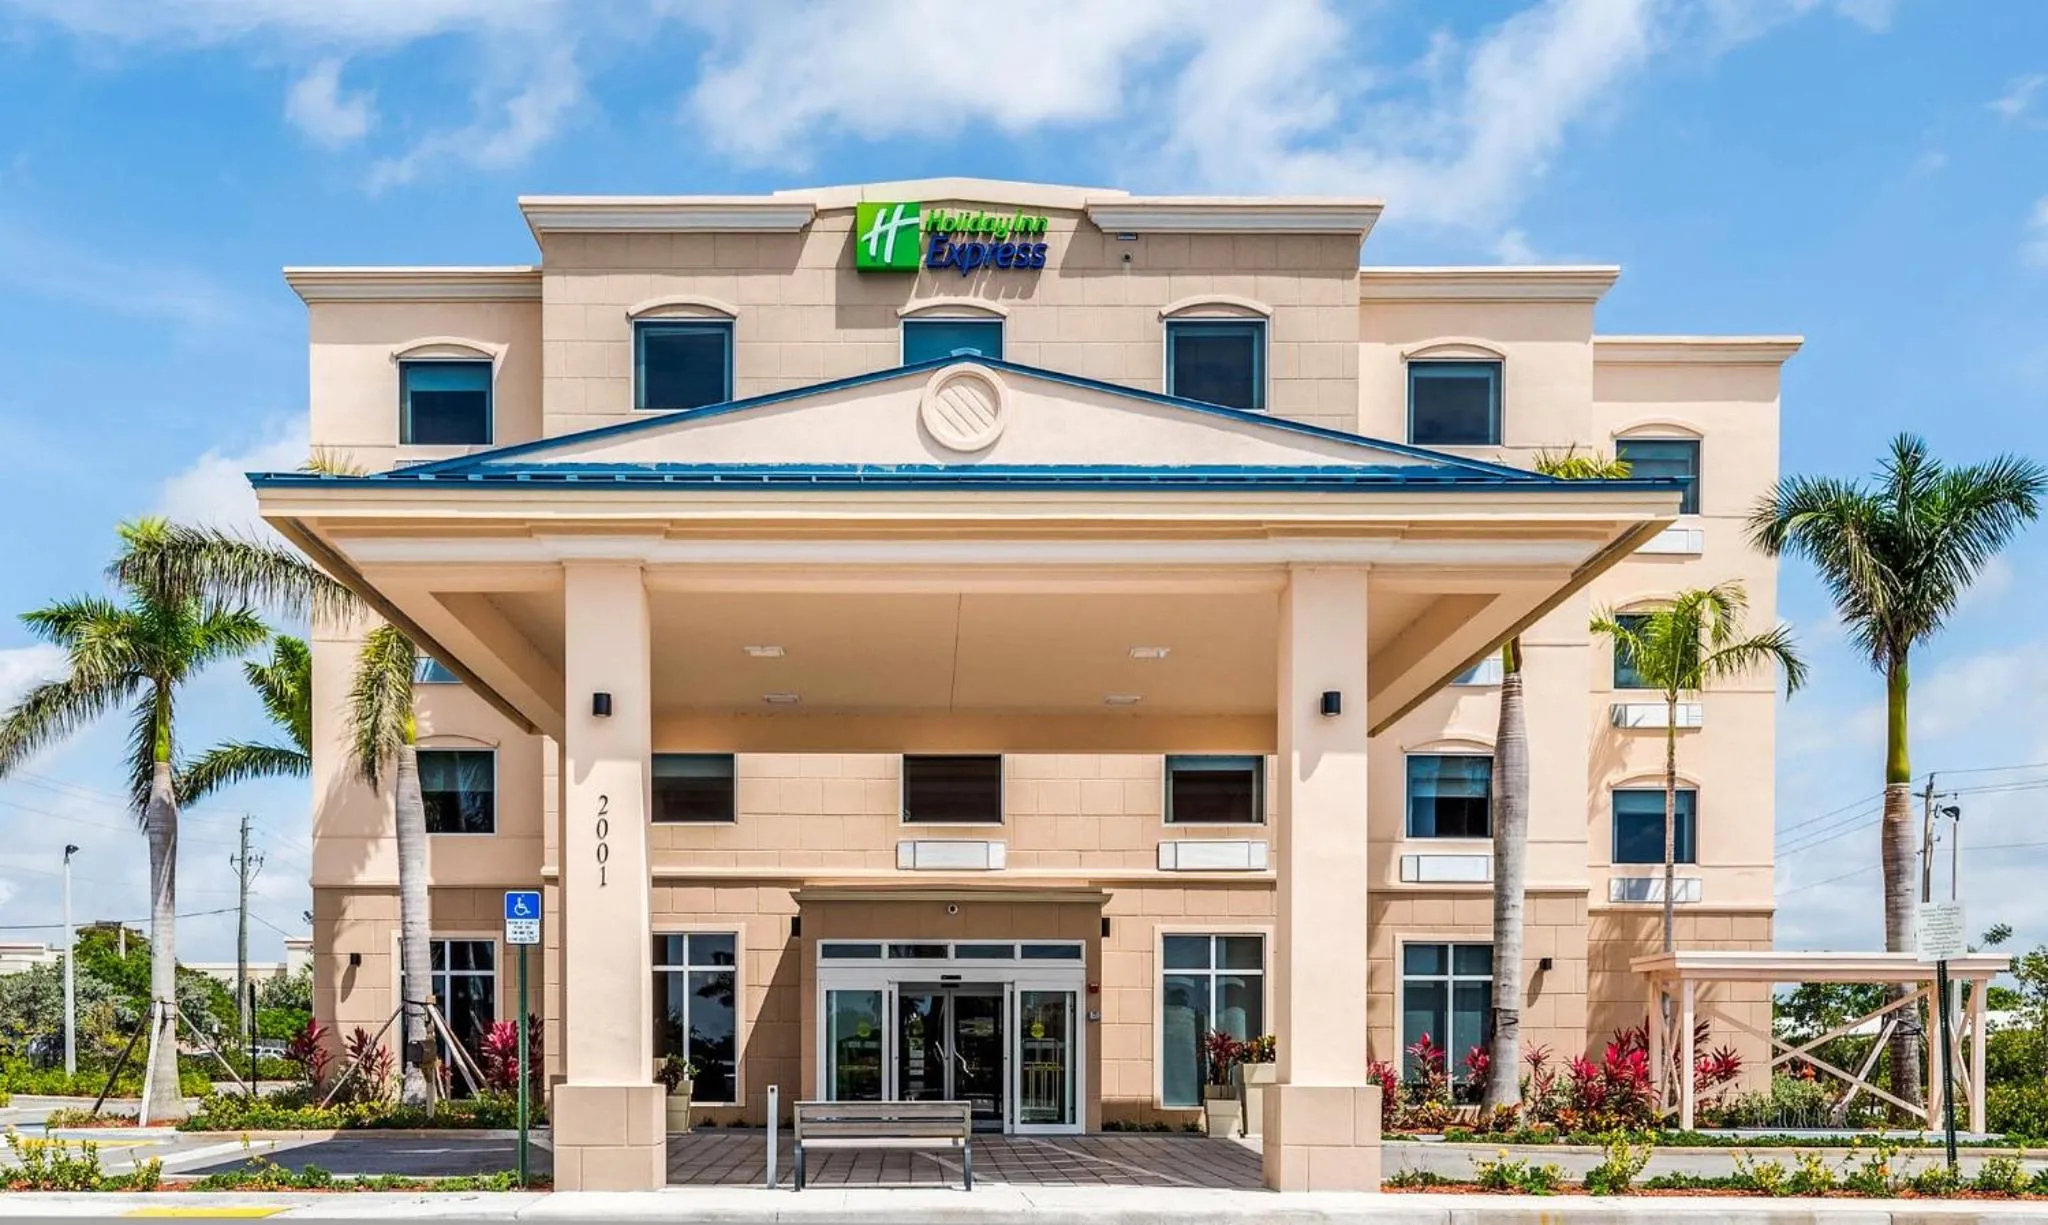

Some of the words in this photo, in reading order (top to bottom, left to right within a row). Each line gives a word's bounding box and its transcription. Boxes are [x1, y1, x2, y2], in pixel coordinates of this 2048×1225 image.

[861, 205, 920, 264] H
[926, 209, 1011, 240] Holiday
[1012, 208, 1048, 233] Inn
[926, 234, 1048, 278] Express
[596, 794, 609, 888] 2001
